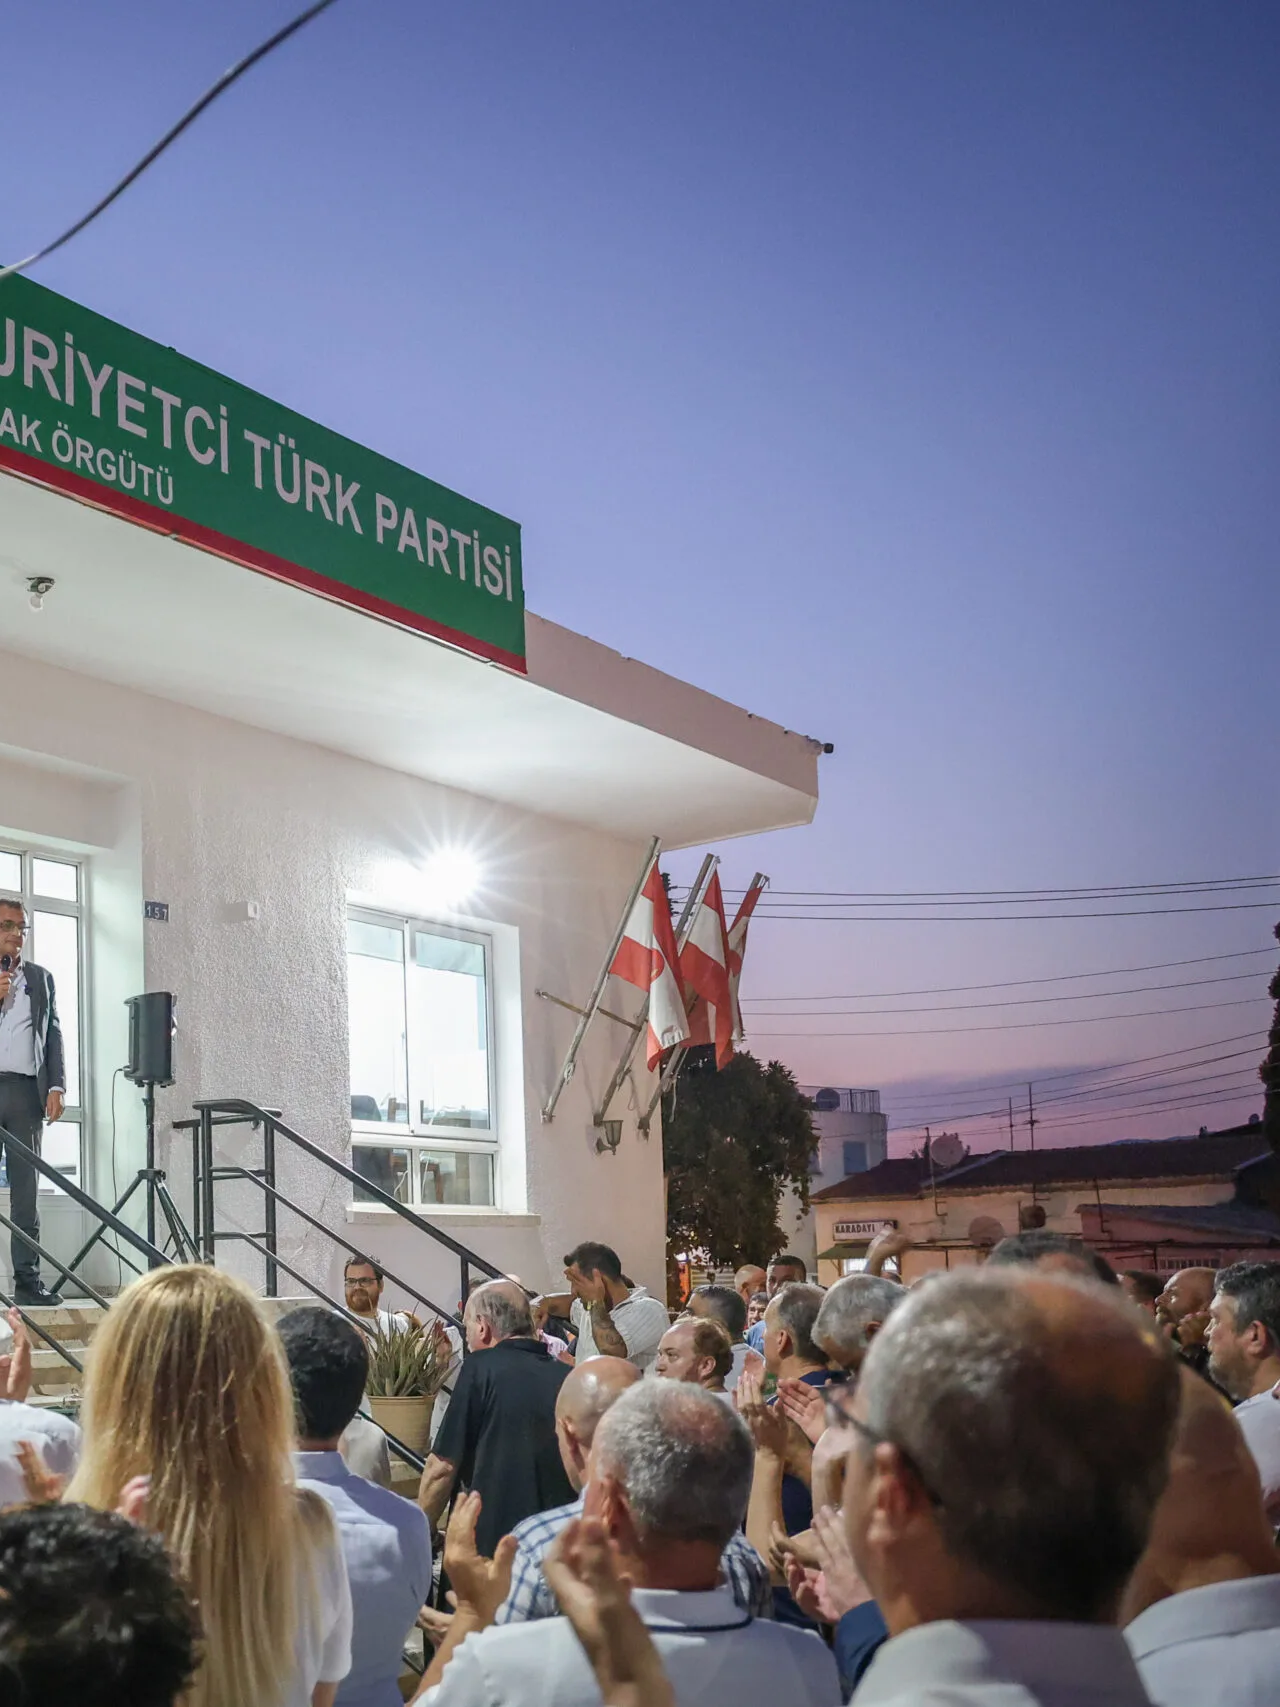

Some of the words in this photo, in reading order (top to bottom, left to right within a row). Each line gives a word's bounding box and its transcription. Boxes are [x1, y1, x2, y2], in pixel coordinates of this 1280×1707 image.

[51, 423, 173, 505] ÖRGÜTÜ
[243, 429, 363, 535] TÜRK
[376, 493, 513, 602] PARTİSİ
[146, 904, 168, 920] 157
[835, 1223, 875, 1234] KARADAYI
